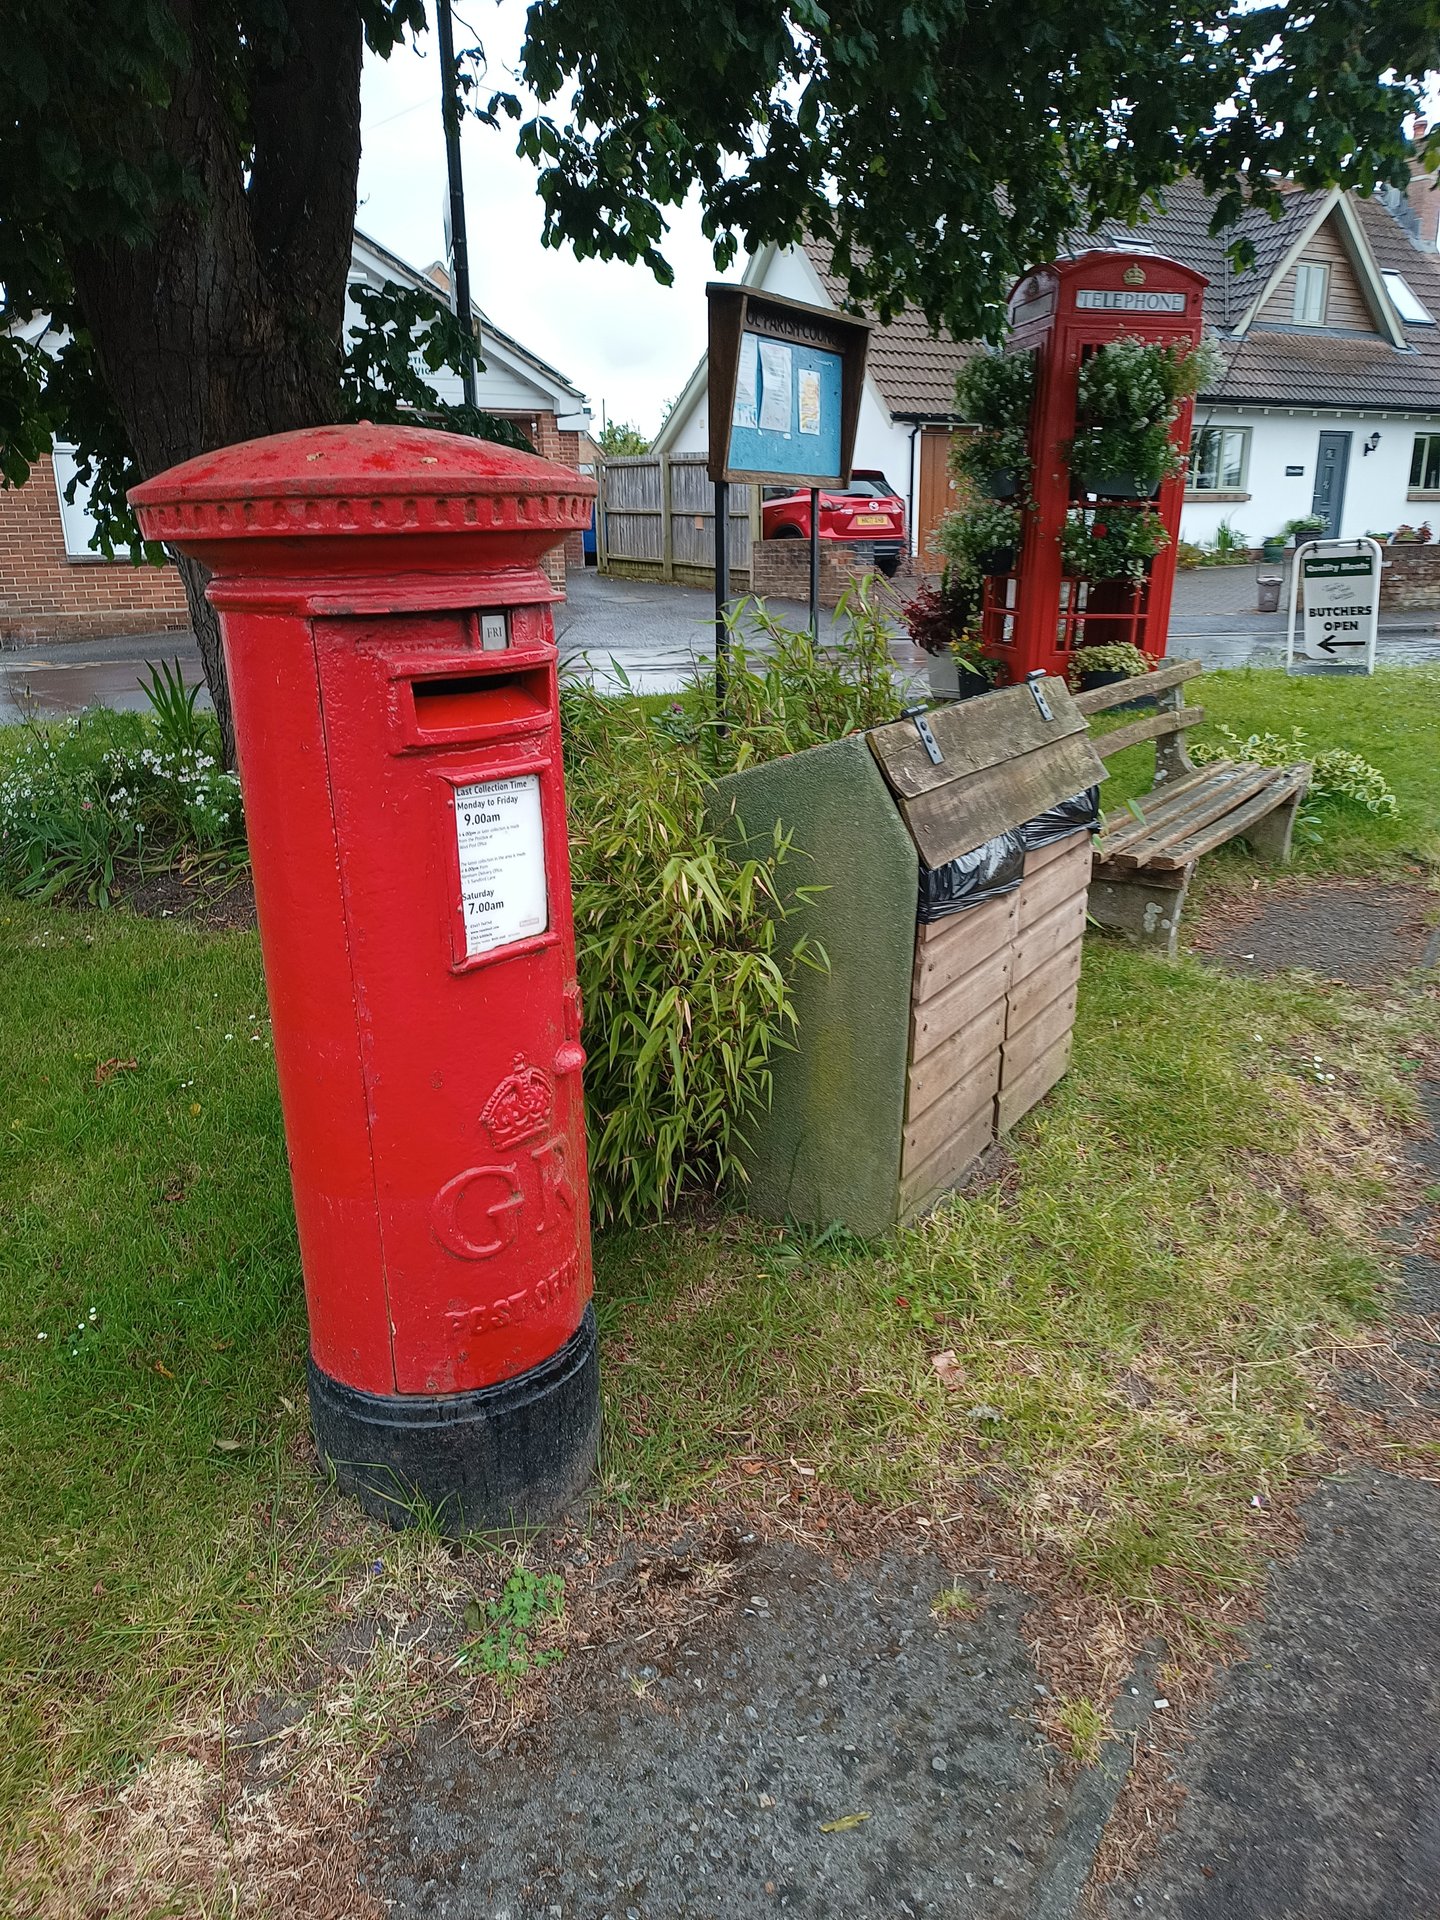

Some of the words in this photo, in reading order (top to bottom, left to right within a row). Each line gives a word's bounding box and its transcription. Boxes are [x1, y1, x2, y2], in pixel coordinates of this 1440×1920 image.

[1080, 292, 1182, 310] TELEPHONE
[763, 313, 800, 339] PARISH
[1308, 605, 1373, 618] BUTCHERS
[486, 626, 503, 639] FRI
[1323, 620, 1359, 632] OPEN
[456, 786, 472, 797] Last
[474, 782, 509, 795] Collection
[509, 779, 527, 790] Time
[457, 800, 486, 811] Monday
[487, 797, 495, 807] to
[496, 795, 519, 806] Friday
[464, 812, 501, 827] 9.00am
[462, 889, 495, 902] Saturday
[468, 900, 505, 915] 7.00am
